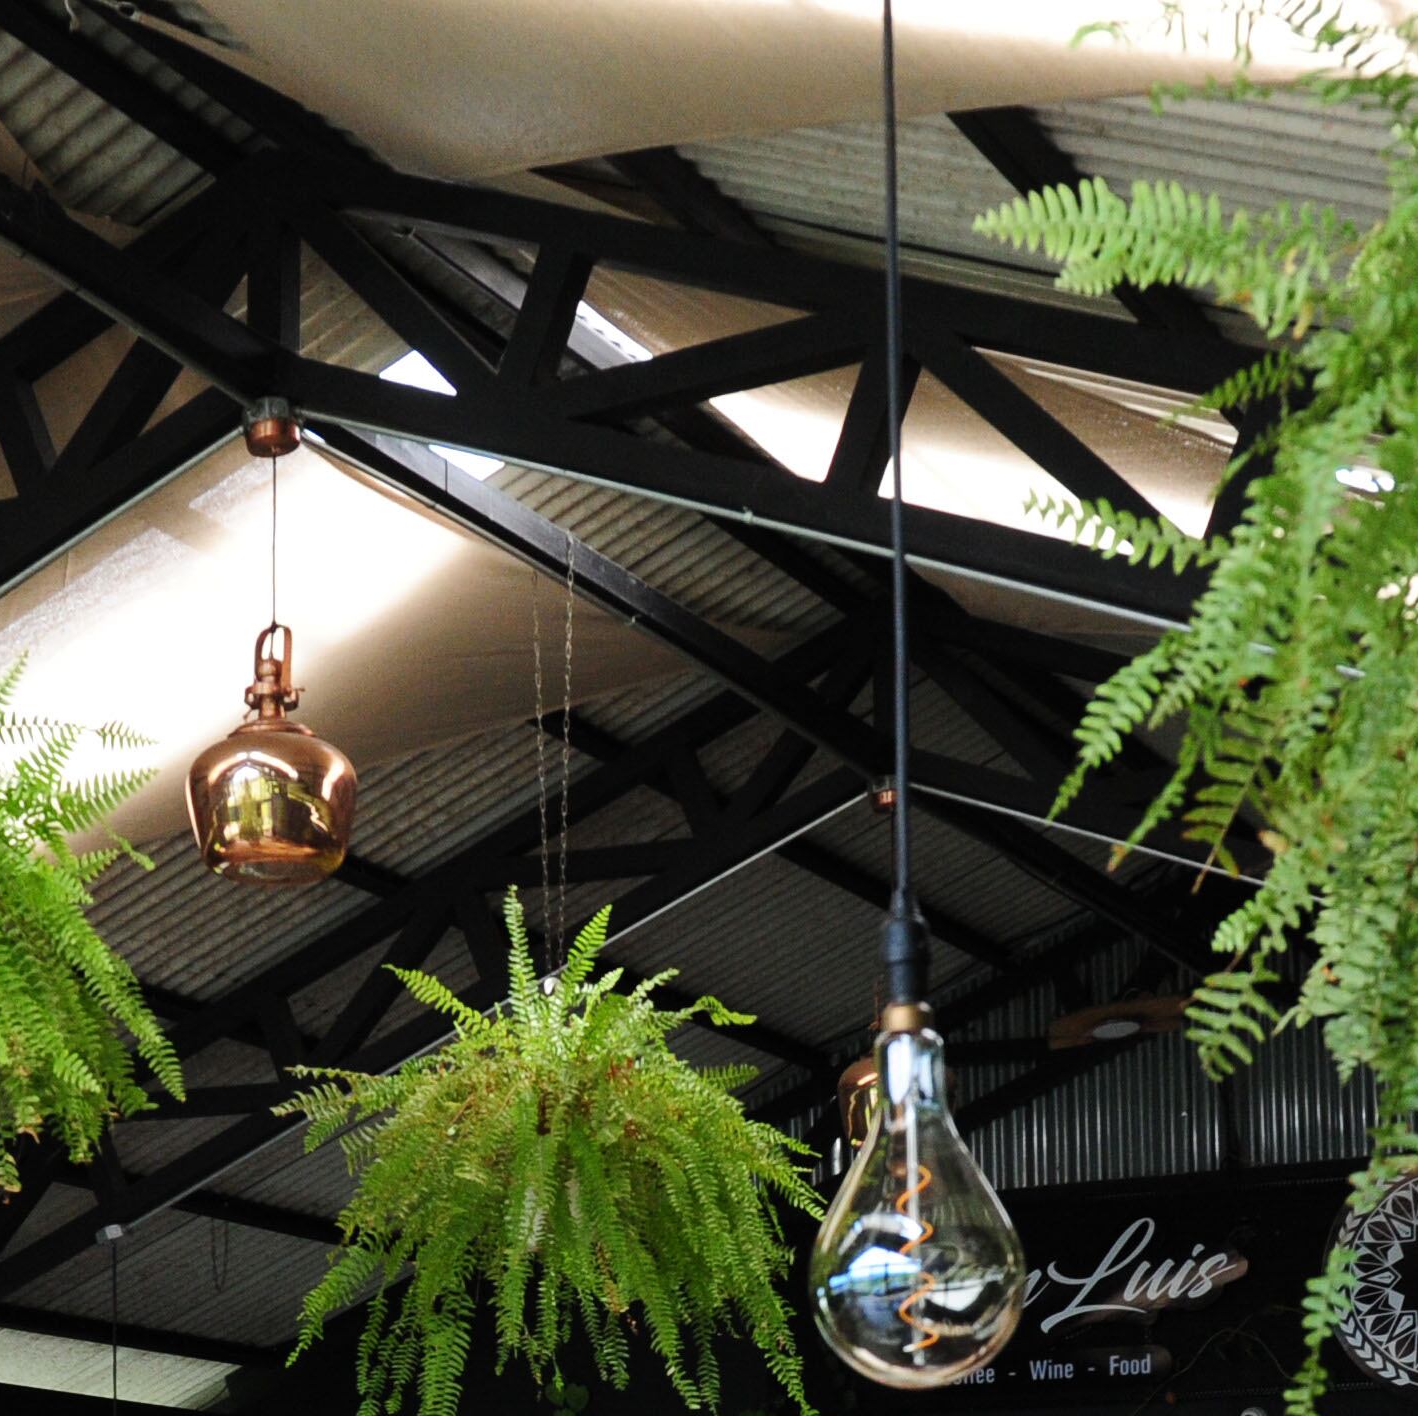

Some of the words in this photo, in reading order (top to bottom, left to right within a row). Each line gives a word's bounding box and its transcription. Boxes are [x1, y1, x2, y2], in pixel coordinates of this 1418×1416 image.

[1040, 1217, 1238, 1335] Luis
[948, 1364, 996, 1387] offee
[1029, 1359, 1074, 1381] Wine
[1109, 1354, 1152, 1376] Food
